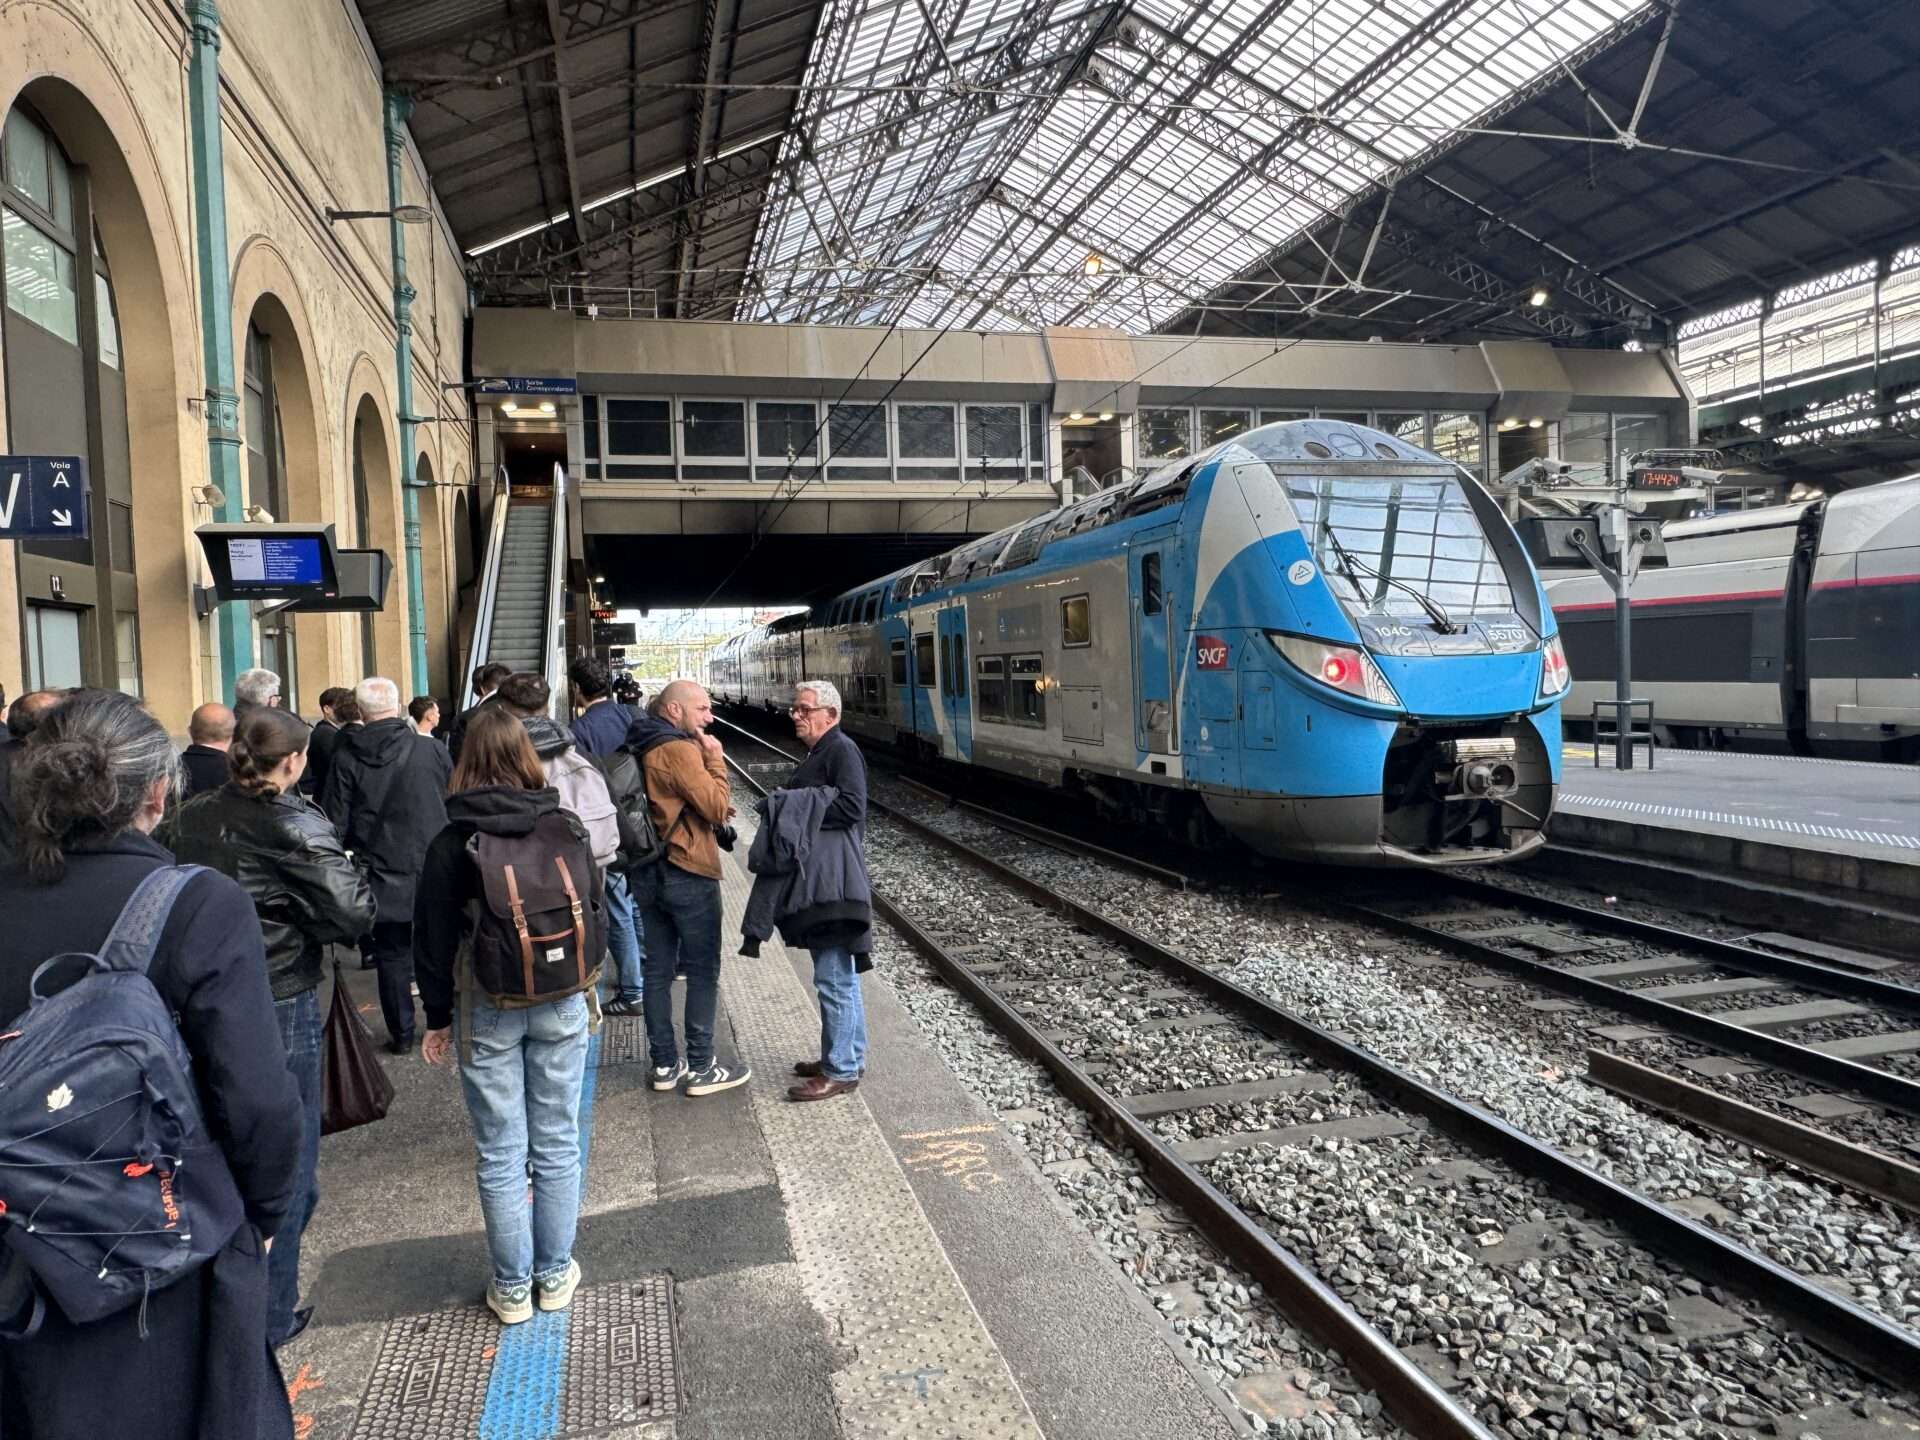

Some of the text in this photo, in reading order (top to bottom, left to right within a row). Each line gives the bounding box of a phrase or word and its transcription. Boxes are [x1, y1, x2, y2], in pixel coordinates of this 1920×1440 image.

[49, 461, 71, 469] Voie
[52, 471, 70, 488] A
[1375, 625, 1412, 637] 104C
[1487, 629, 1528, 641] 55707
[1197, 647, 1226, 665] SNCF
